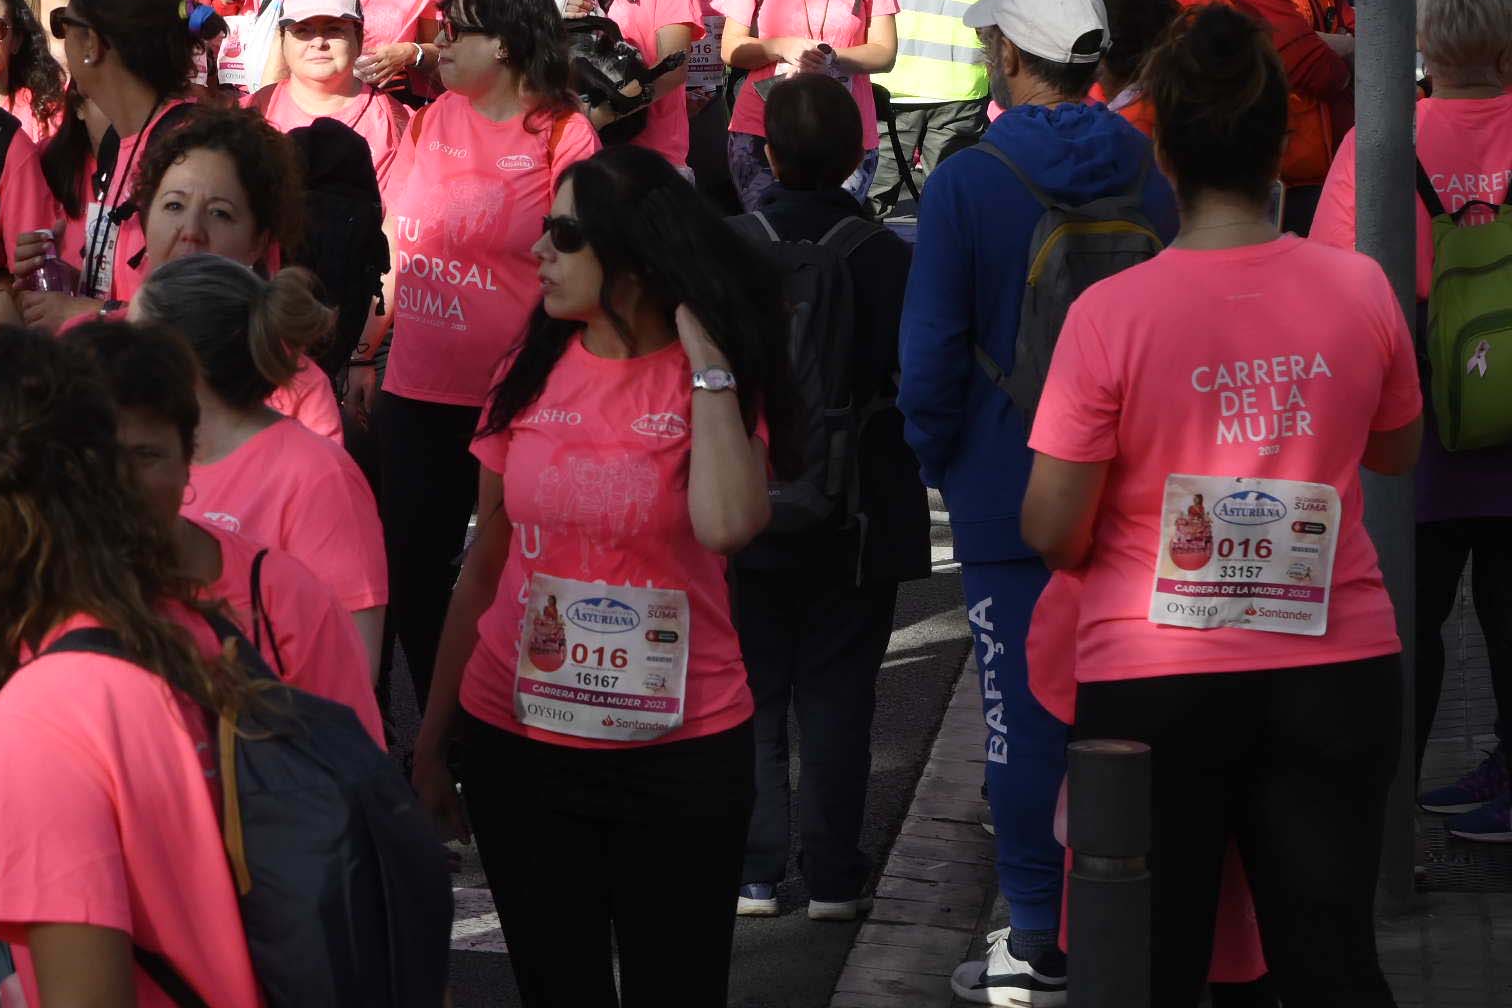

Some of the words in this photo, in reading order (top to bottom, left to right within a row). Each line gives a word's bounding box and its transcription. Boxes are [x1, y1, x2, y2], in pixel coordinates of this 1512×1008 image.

[397, 215, 421, 242] TU
[399, 250, 497, 291] DORSAL
[399, 285, 465, 321] SUMA
[1191, 351, 1333, 393] CARRERA
[1220, 388, 1258, 417] DE
[1270, 383, 1306, 411] LA
[1215, 410, 1316, 445] MUJER
[1219, 502, 1281, 519] ASTURIANA
[1294, 502, 1328, 513] SUMA
[1217, 537, 1273, 559] 016
[1219, 565, 1263, 579] 33157
[1174, 584, 1220, 594] CARRERA
[1222, 585, 1236, 595] DE
[1236, 586, 1250, 595] LA
[1251, 586, 1285, 596] MUJER
[572, 608, 635, 628] ASTURIANA
[647, 609, 679, 621] SUMA
[1167, 602, 1219, 617] OYSHO
[1257, 606, 1312, 621] Santander
[570, 643, 629, 669] 016
[575, 671, 620, 689] 16167
[532, 684, 575, 700] CARRERA
[576, 691, 590, 702] DE
[591, 694, 605, 704] LA
[606, 695, 641, 708] MUJER
[527, 703, 575, 723] OYSHO
[615, 717, 669, 731] Santander
